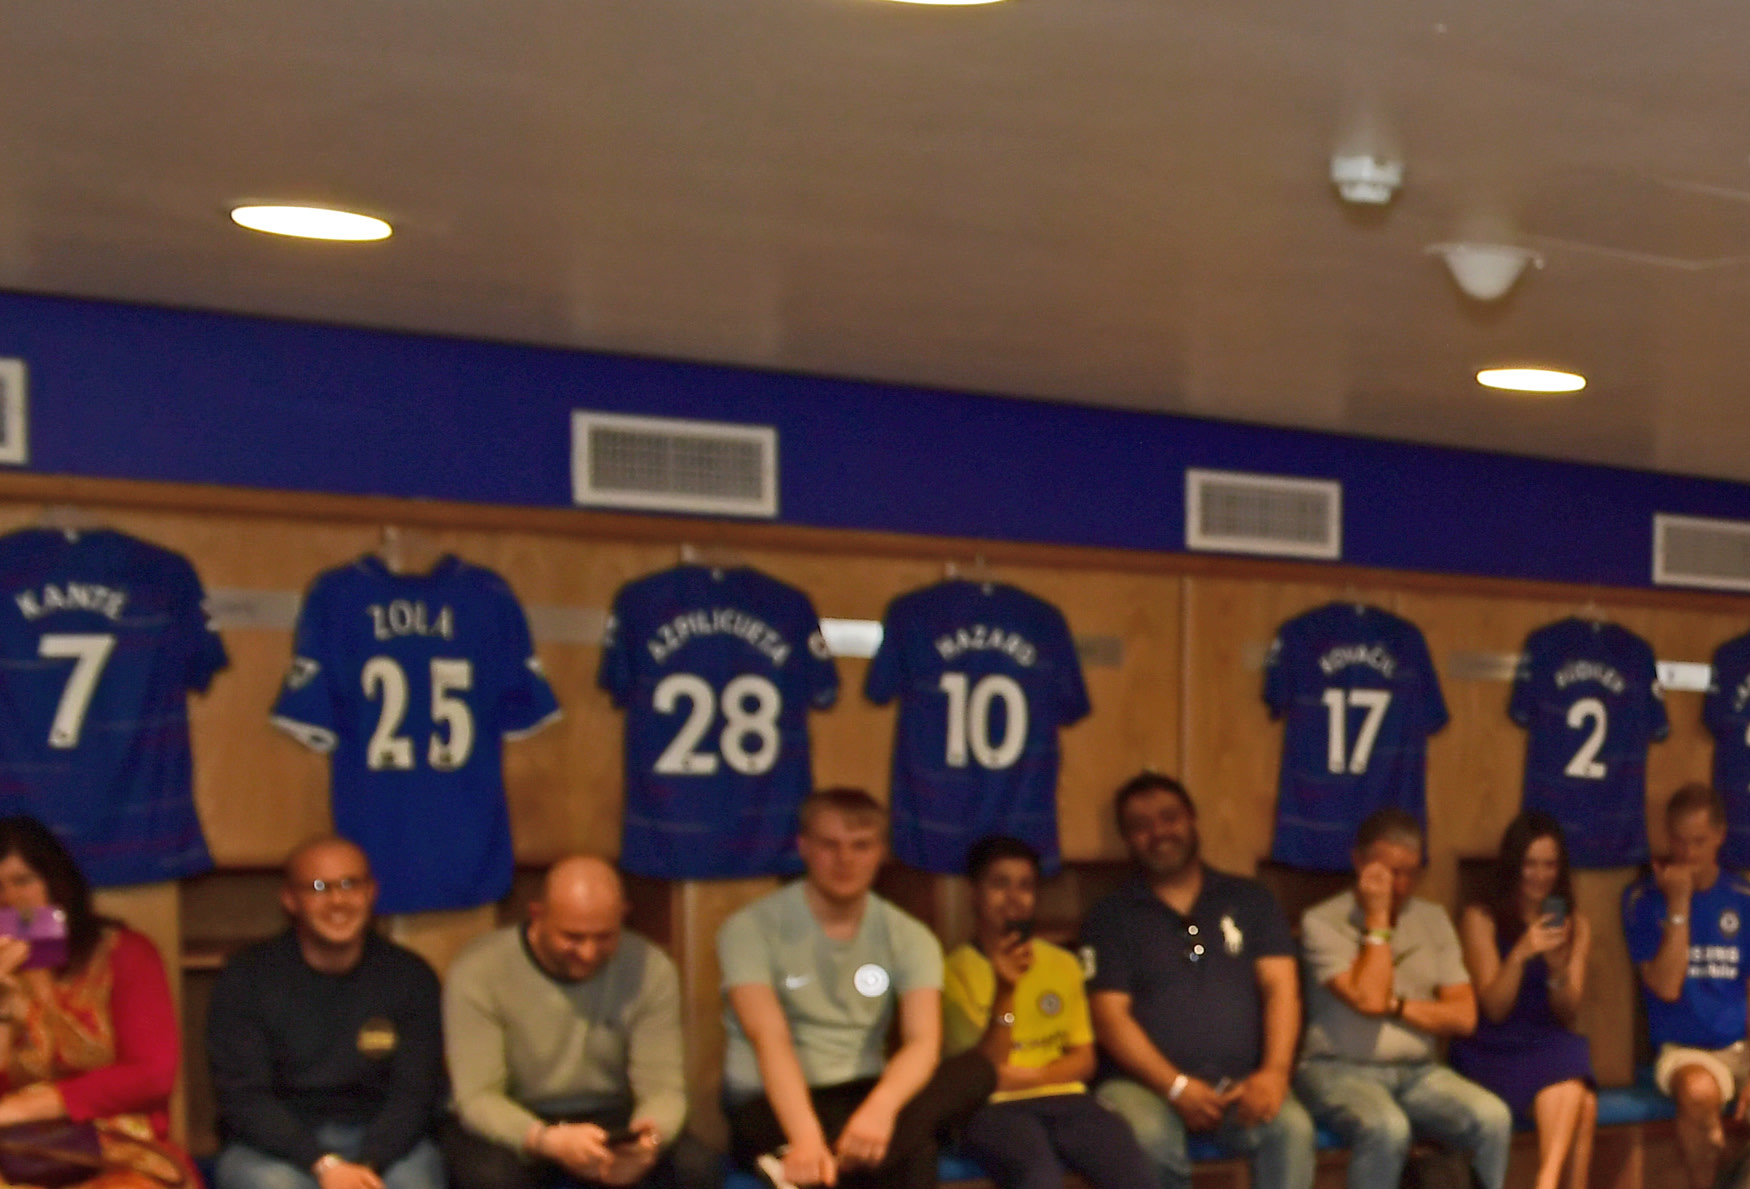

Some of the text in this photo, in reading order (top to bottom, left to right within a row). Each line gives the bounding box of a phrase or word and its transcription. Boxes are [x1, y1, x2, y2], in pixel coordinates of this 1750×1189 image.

[366, 598, 455, 640] ZOLA
[648, 608, 790, 668] AZPILICUETA
[935, 624, 1037, 668] HAZARD
[37, 633, 116, 748] 7
[361, 655, 475, 771] 25
[652, 672, 782, 775] 28
[939, 671, 1029, 770] 10
[1322, 688, 1392, 775] 17
[1564, 697, 1608, 779] 2
